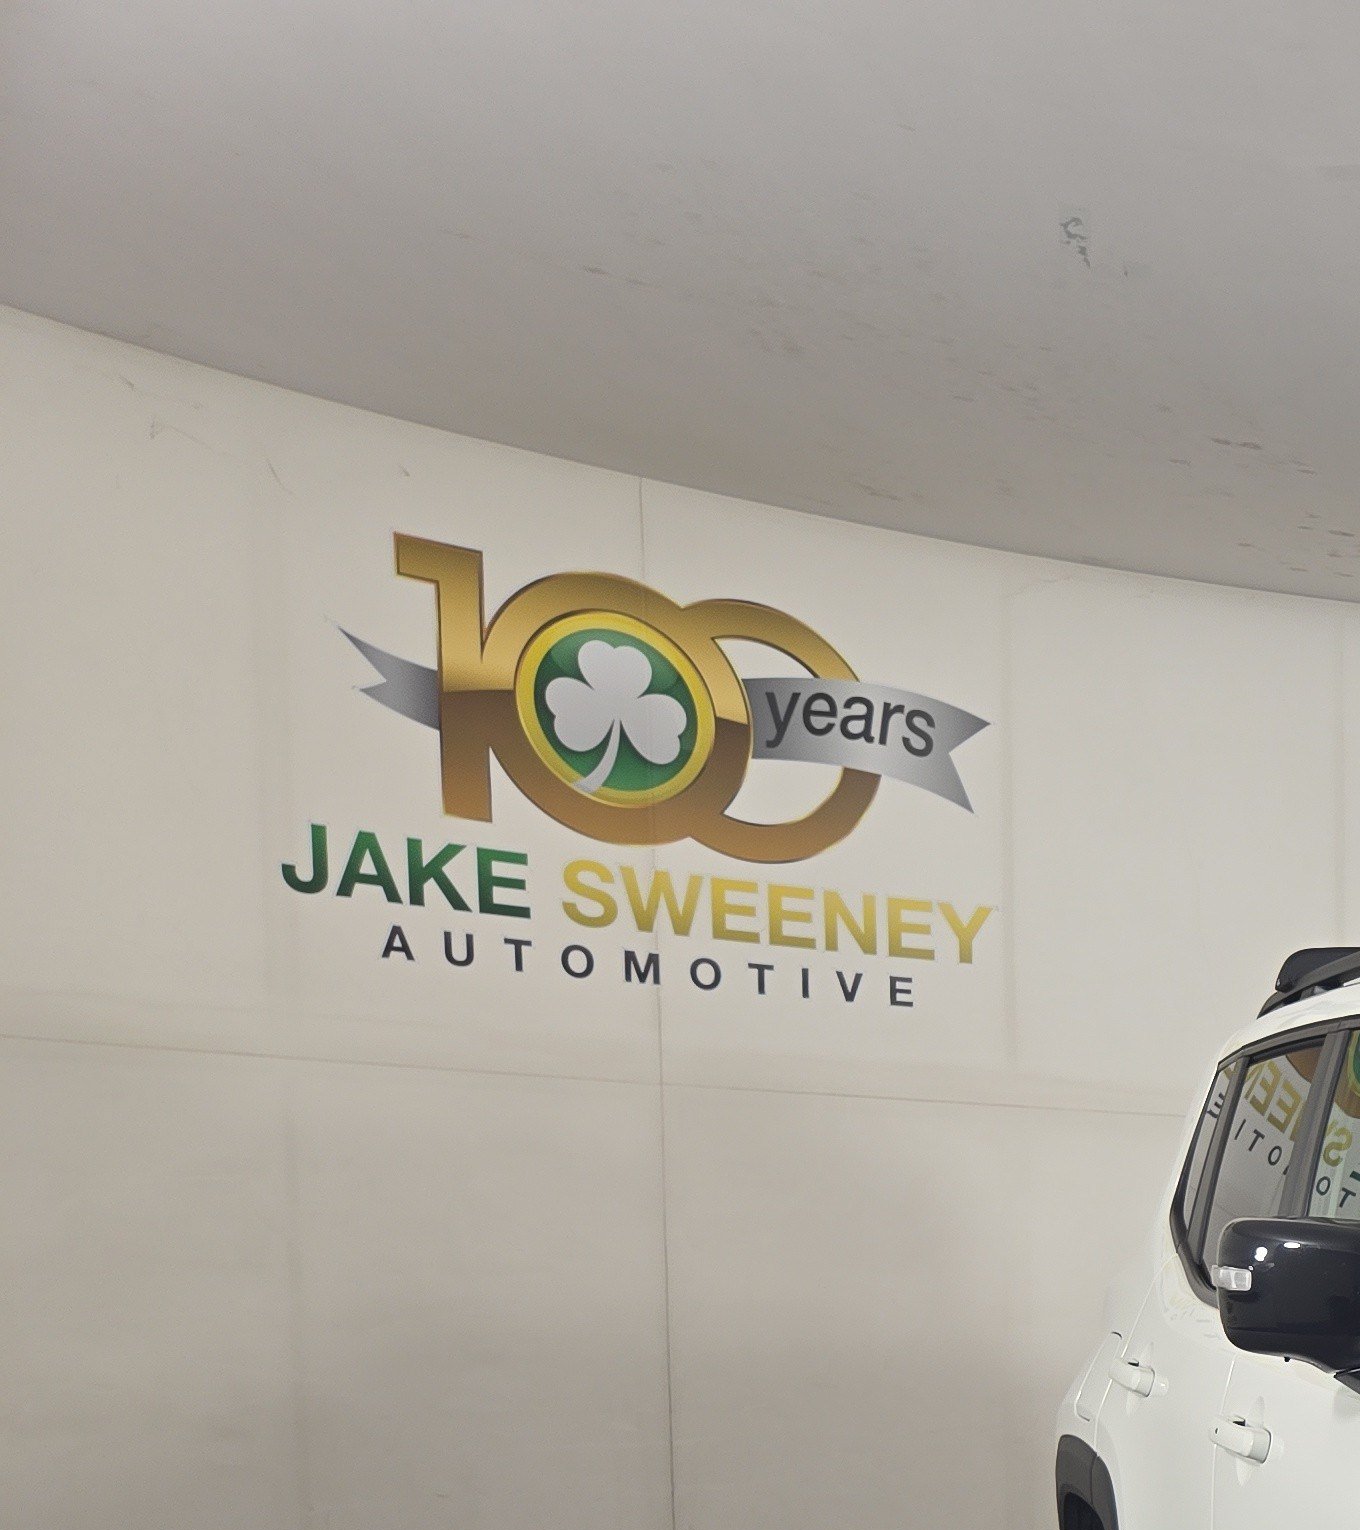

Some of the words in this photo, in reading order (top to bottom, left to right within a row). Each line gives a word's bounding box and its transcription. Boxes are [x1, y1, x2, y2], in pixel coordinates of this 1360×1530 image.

[394, 531, 882, 864] 100
[763, 689, 937, 757] years
[281, 823, 531, 919] JAKE
[561, 859, 993, 964] SWEENEY
[381, 924, 914, 1007] AUTOMOTIVE
